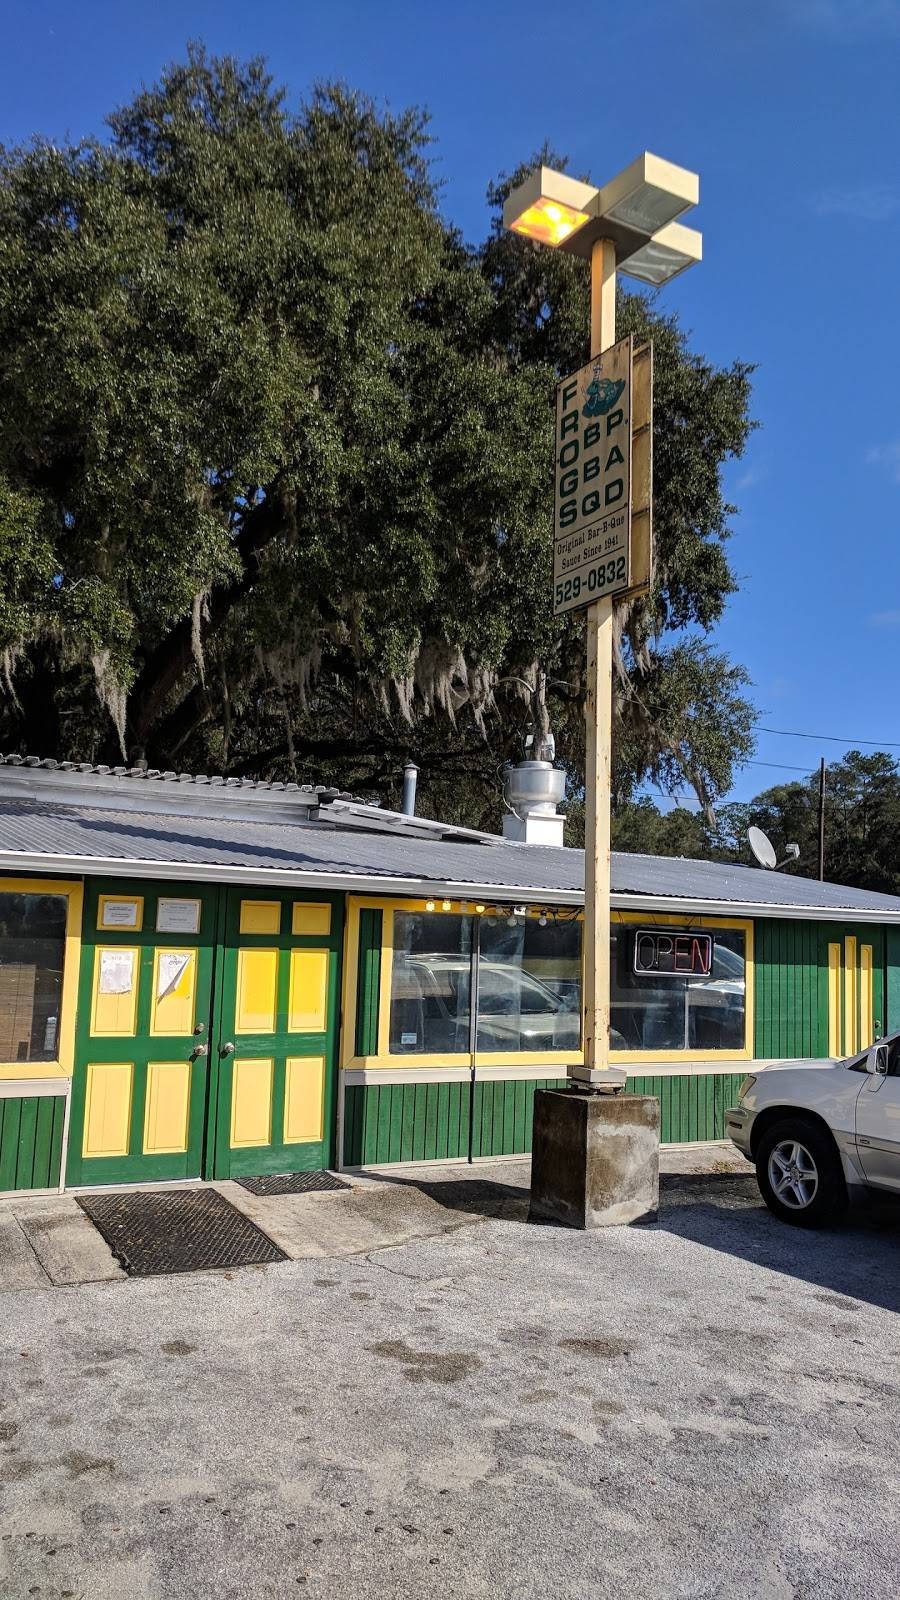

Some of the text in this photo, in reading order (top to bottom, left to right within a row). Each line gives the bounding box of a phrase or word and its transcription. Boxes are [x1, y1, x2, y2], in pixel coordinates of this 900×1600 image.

[559, 380, 579, 529] FROGS
[581, 422, 601, 517] BBQ
[604, 408, 624, 507] PAD
[557, 514, 625, 555] Original Bar-B-Que
[561, 535, 619, 570] Sauce Since 1941
[555, 556, 626, 605] 529-0832
[638, 936, 709, 972] OPEN
